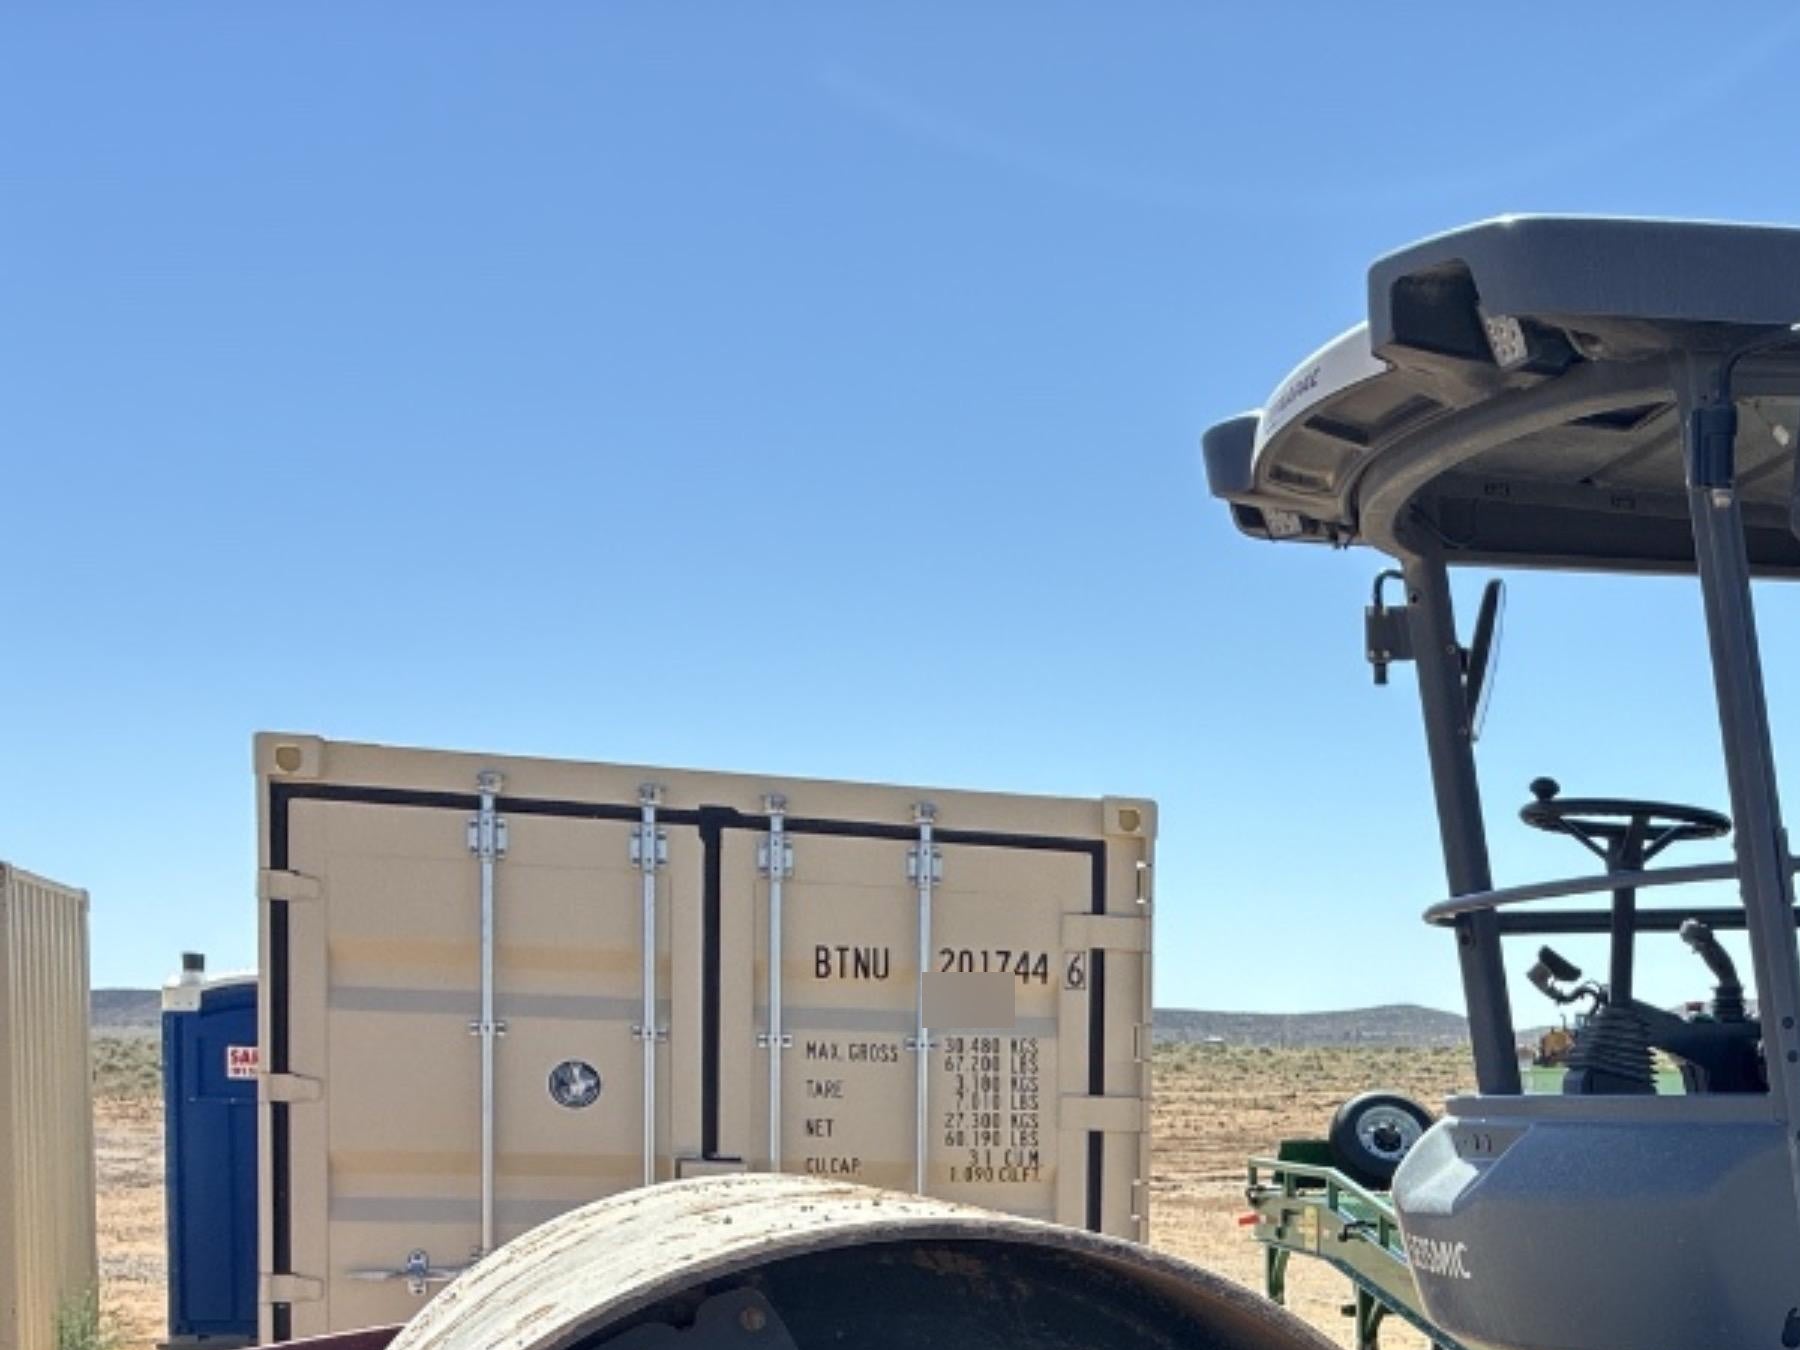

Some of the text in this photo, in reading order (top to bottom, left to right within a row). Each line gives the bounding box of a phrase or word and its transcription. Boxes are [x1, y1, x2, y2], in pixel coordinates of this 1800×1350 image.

[814, 944, 890, 981] BTNU
[1067, 951, 1085, 989] 6
[848, 1043, 898, 1063] GROSS
[806, 1118, 834, 1138] NET
